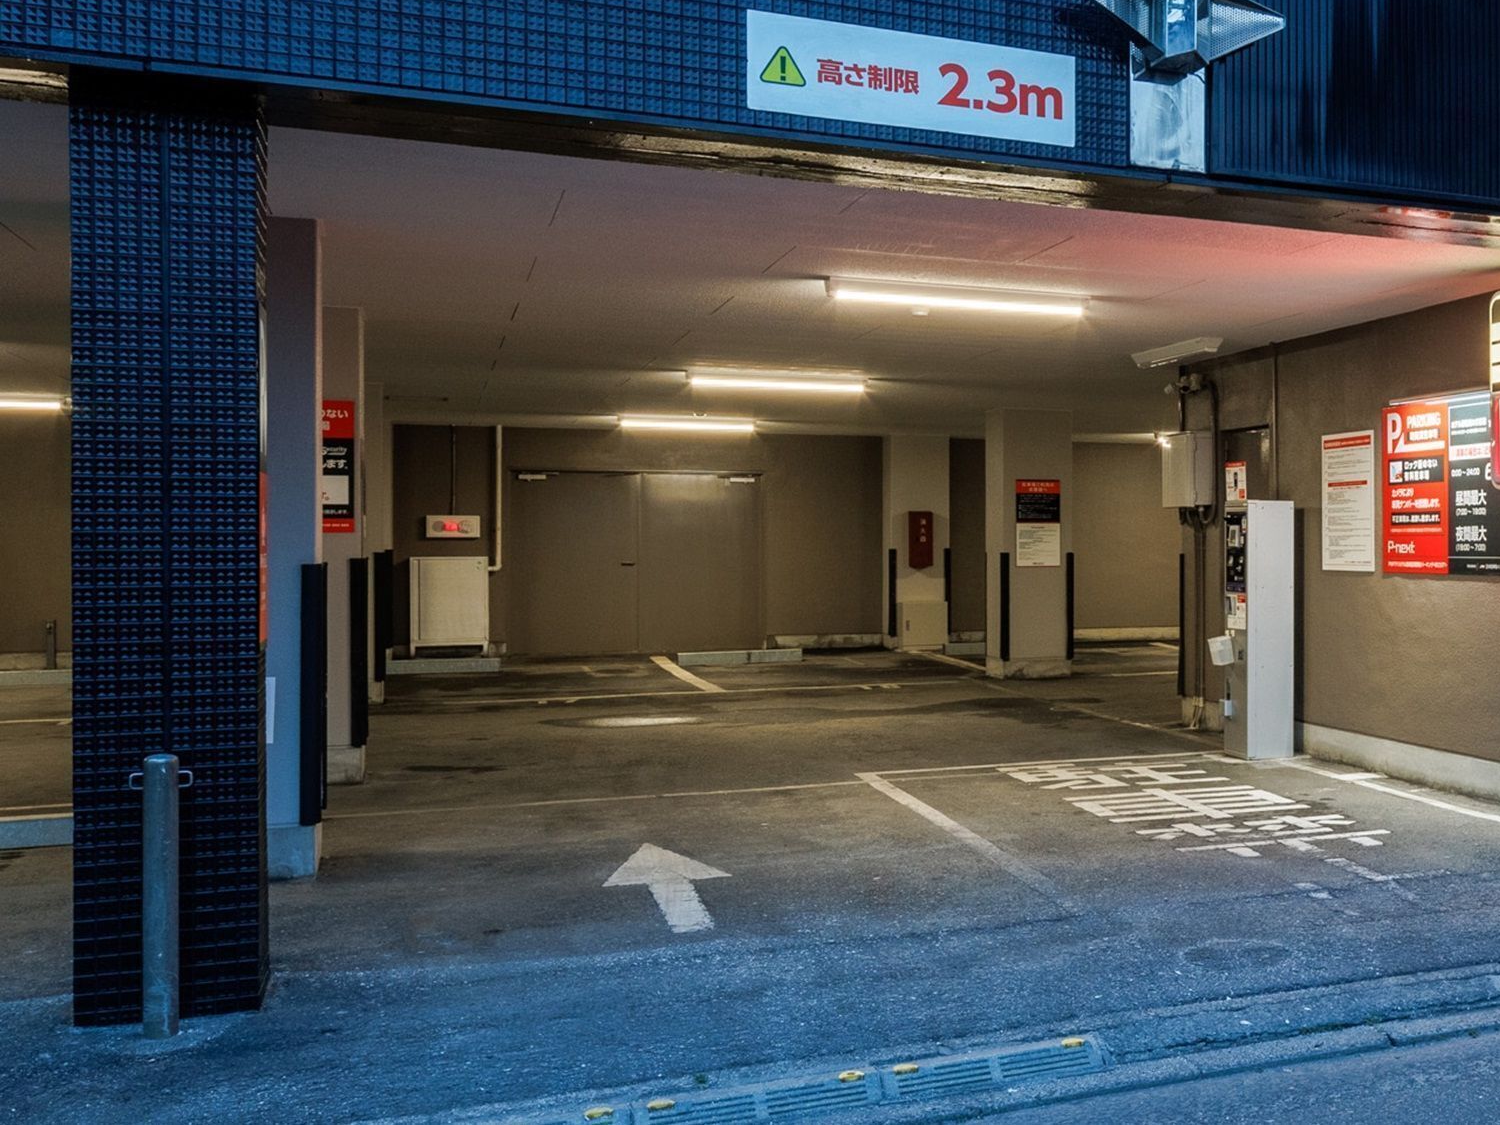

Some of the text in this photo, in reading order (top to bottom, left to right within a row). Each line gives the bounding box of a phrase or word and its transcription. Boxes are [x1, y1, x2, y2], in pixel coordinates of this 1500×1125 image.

[816, 58, 1063, 120] 高さ制限 2.3m
[1456, 489, 1487, 506] 昼間最大
[1455, 525, 1487, 542] 夜間最大
